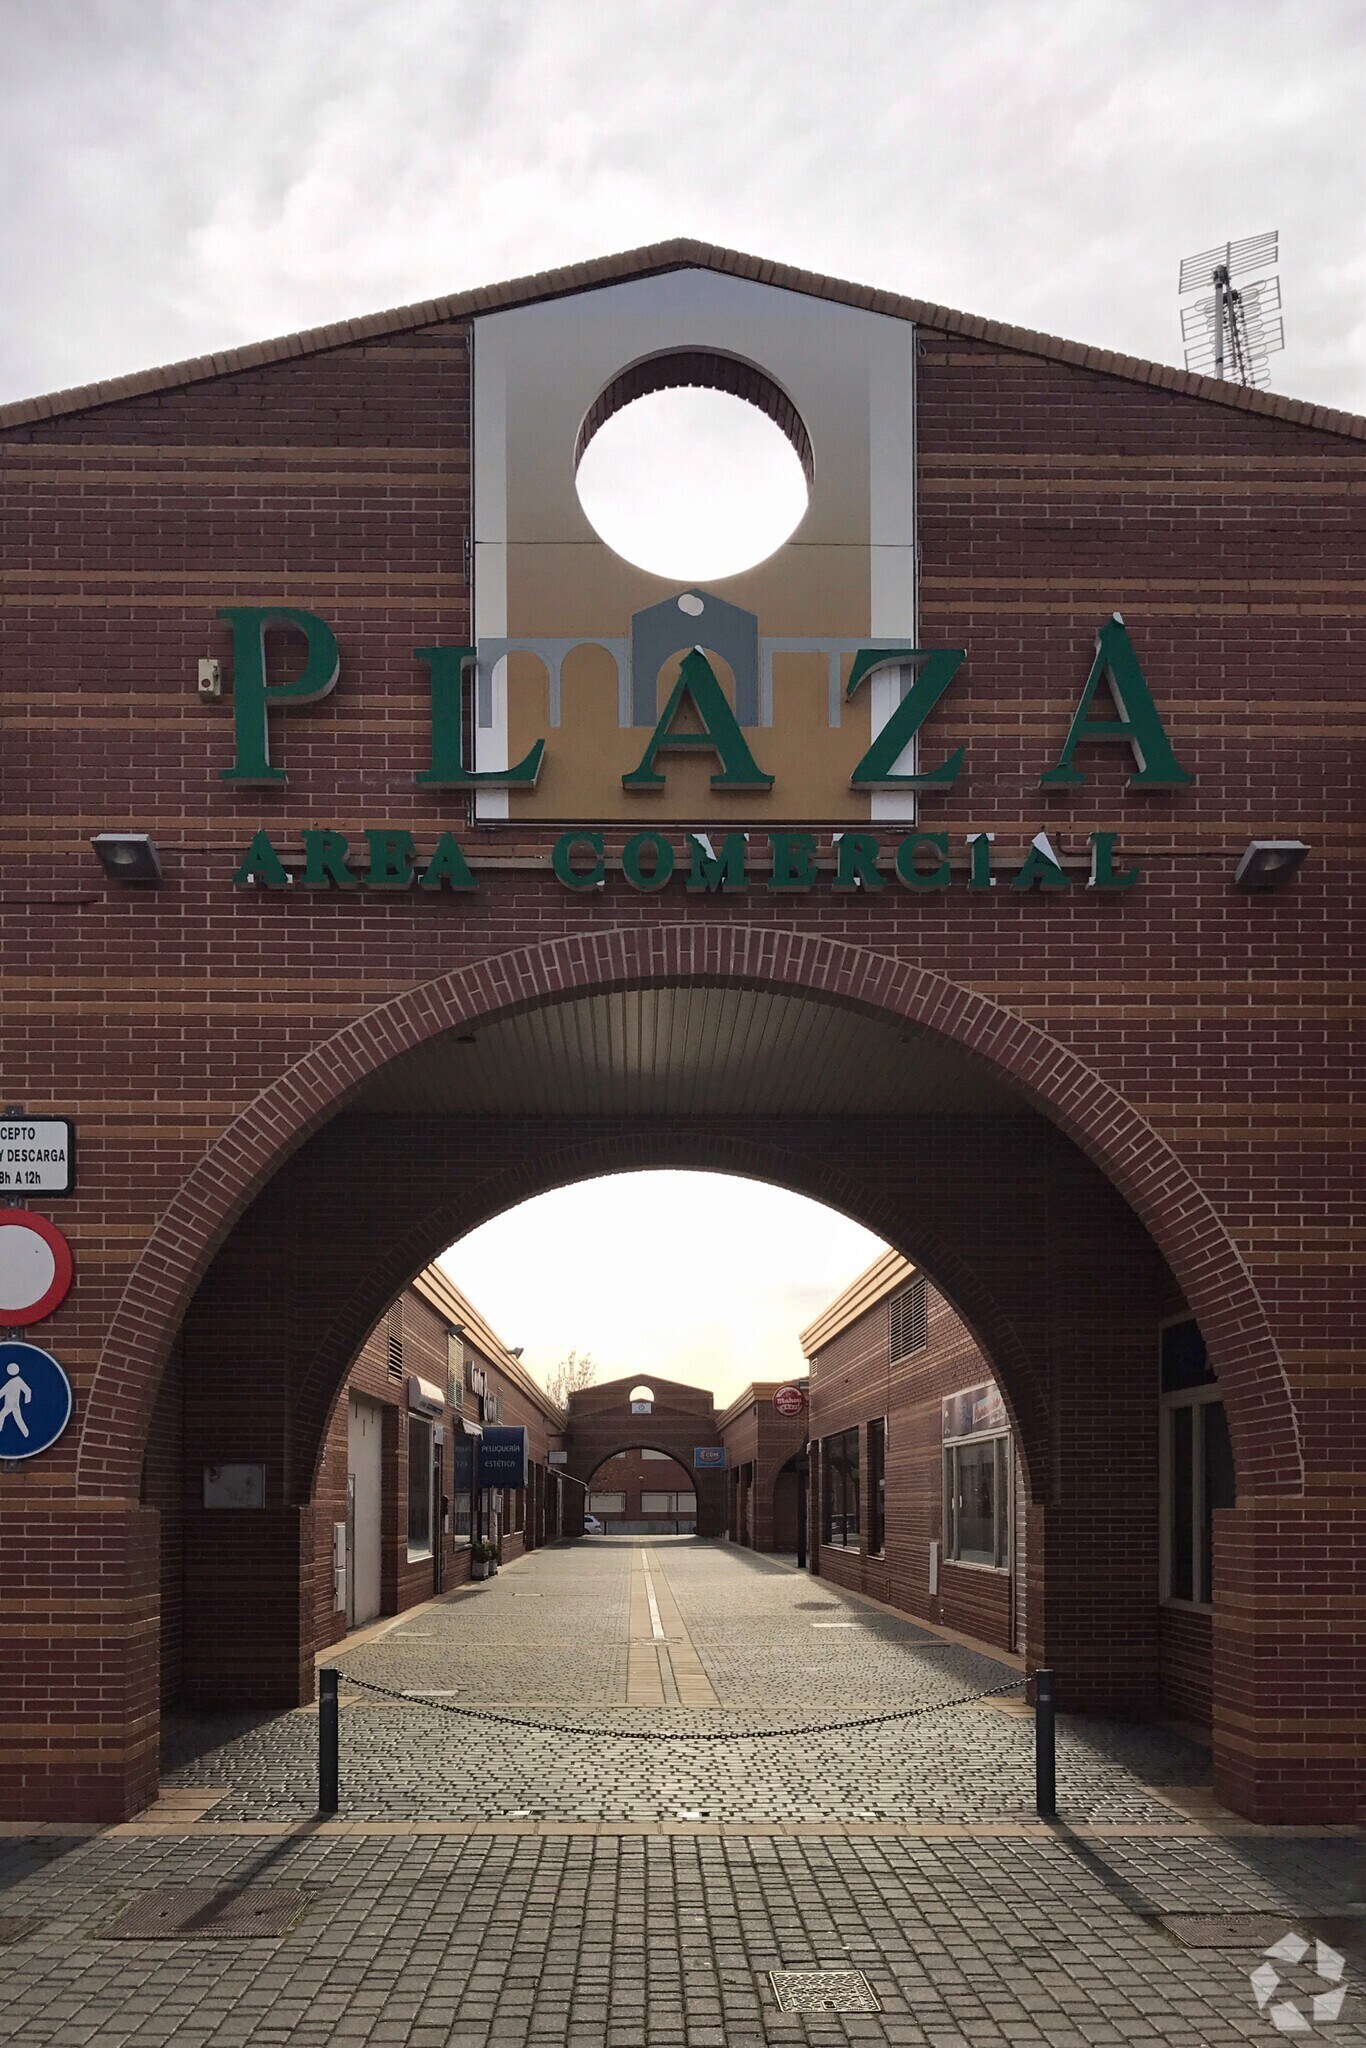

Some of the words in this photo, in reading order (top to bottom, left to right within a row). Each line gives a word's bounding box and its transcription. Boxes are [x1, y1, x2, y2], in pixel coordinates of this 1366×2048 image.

[217, 606, 1195, 791] PLAZA
[232, 829, 481, 893] AREA
[551, 831, 1141, 893] COMERCIAL
[7, 1149, 65, 1162] DESCARGA
[15, 1171, 22, 1184] A
[25, 1171, 41, 1184] 12h
[481, 1444, 520, 1453] PELUQUERÍA
[484, 1459, 516, 1468] ESTÉTICA
